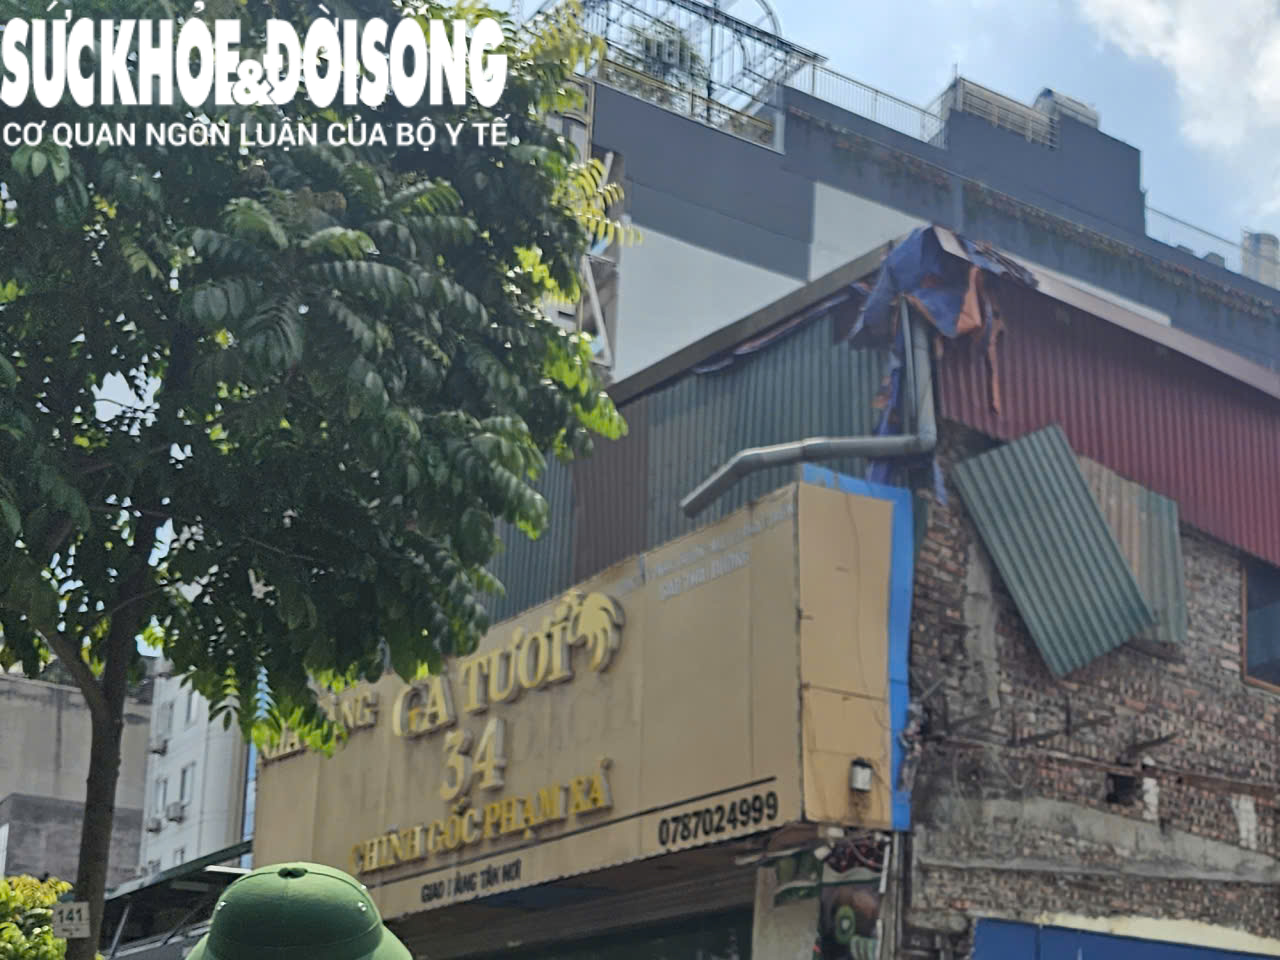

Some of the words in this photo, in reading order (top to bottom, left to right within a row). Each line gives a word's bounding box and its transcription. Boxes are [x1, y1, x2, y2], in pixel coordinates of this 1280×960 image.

[440, 716, 508, 801] 34
[428, 796, 485, 852] GỐC
[658, 791, 779, 847] 0787024999
[57, 908, 82, 923] 141
